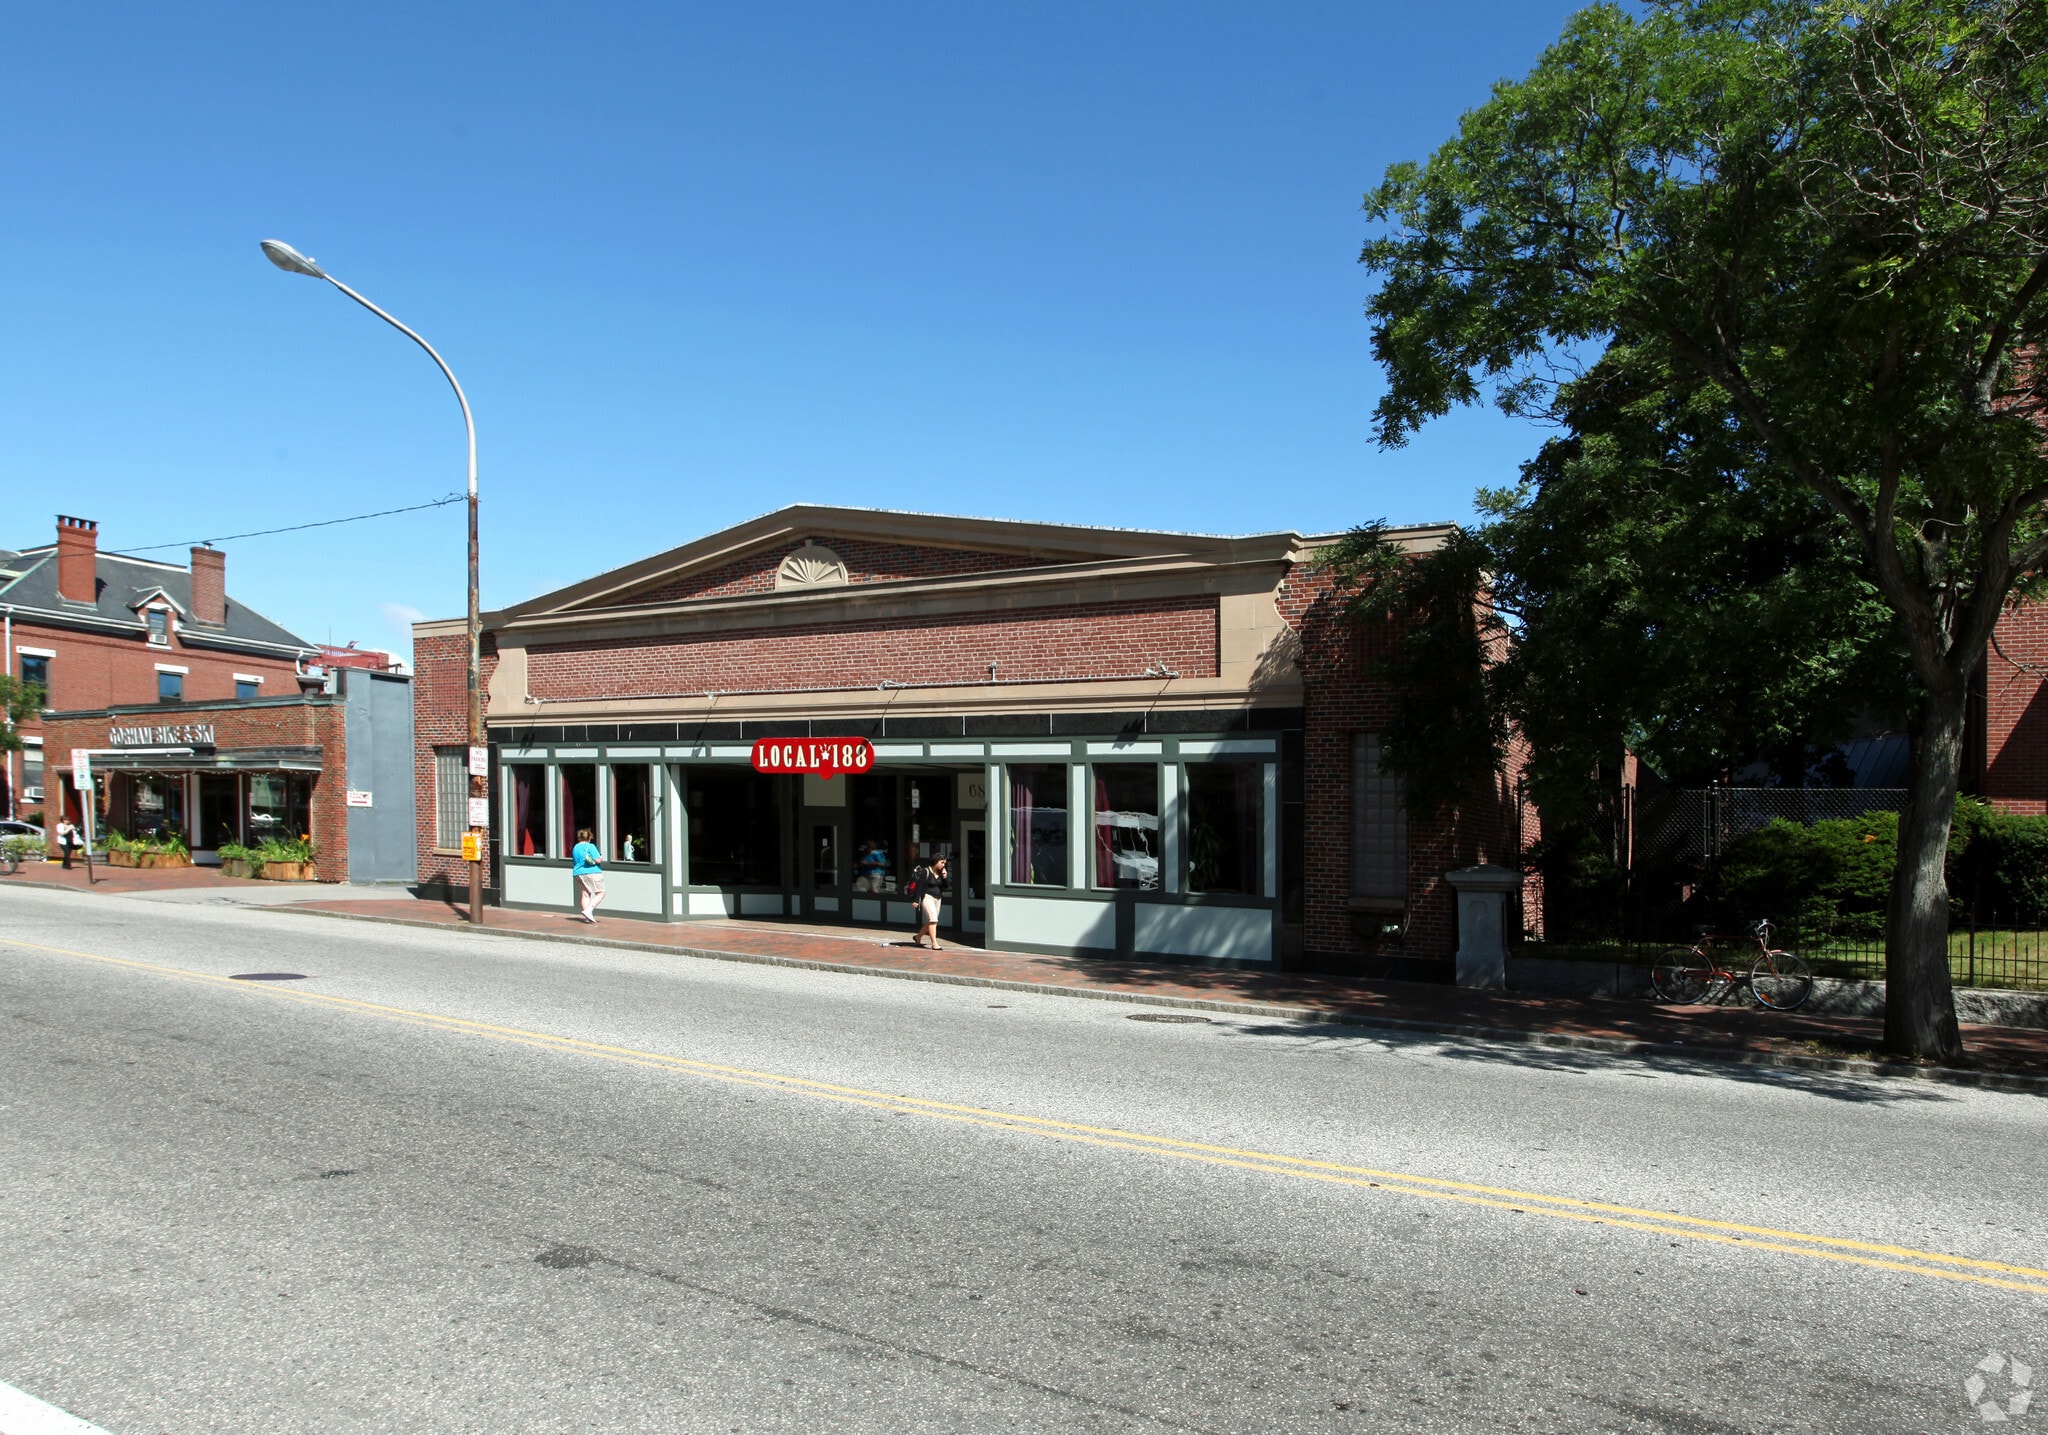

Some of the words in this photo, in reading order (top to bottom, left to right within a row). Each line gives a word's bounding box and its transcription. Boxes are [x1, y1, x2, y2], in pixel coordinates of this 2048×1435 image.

[110, 727, 152, 744] GORHAM
[156, 726, 181, 744] BIKE
[184, 725, 193, 744] &
[195, 724, 215, 743] SKI
[758, 744, 820, 768] LOCAL
[832, 743, 867, 768] 188
